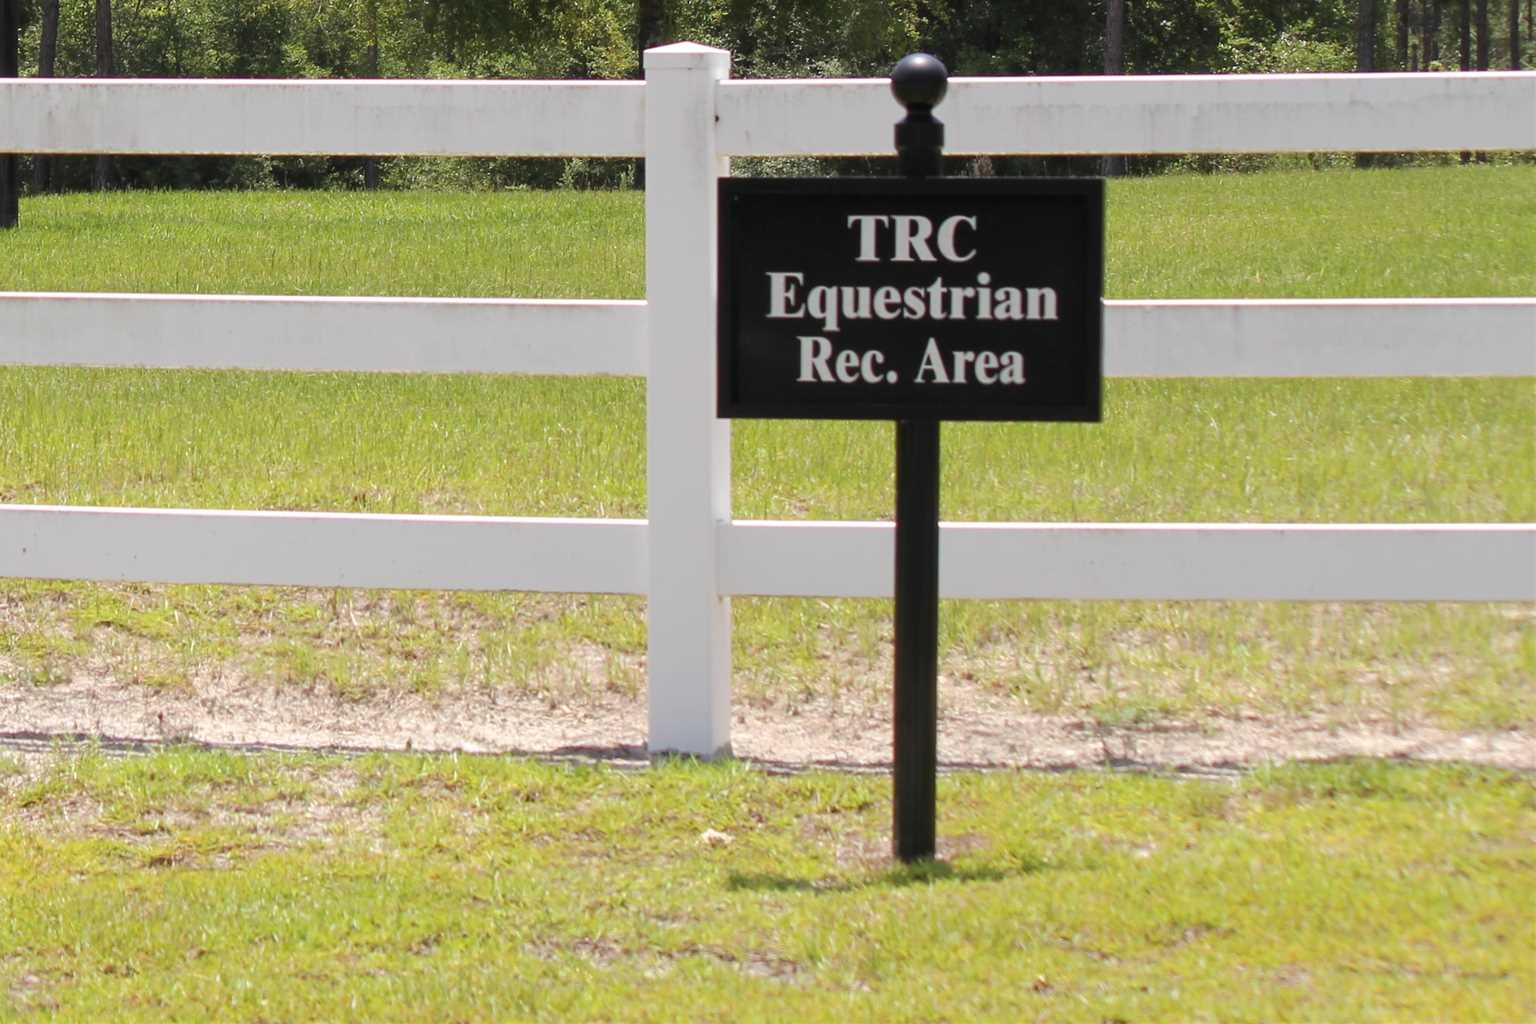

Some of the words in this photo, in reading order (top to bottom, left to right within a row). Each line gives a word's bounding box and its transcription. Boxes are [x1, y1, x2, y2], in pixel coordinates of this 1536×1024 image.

[847, 214, 978, 263] TRC
[766, 271, 1059, 332] Equestrian
[796, 336, 899, 384] Rec.
[914, 336, 1026, 385] Area
